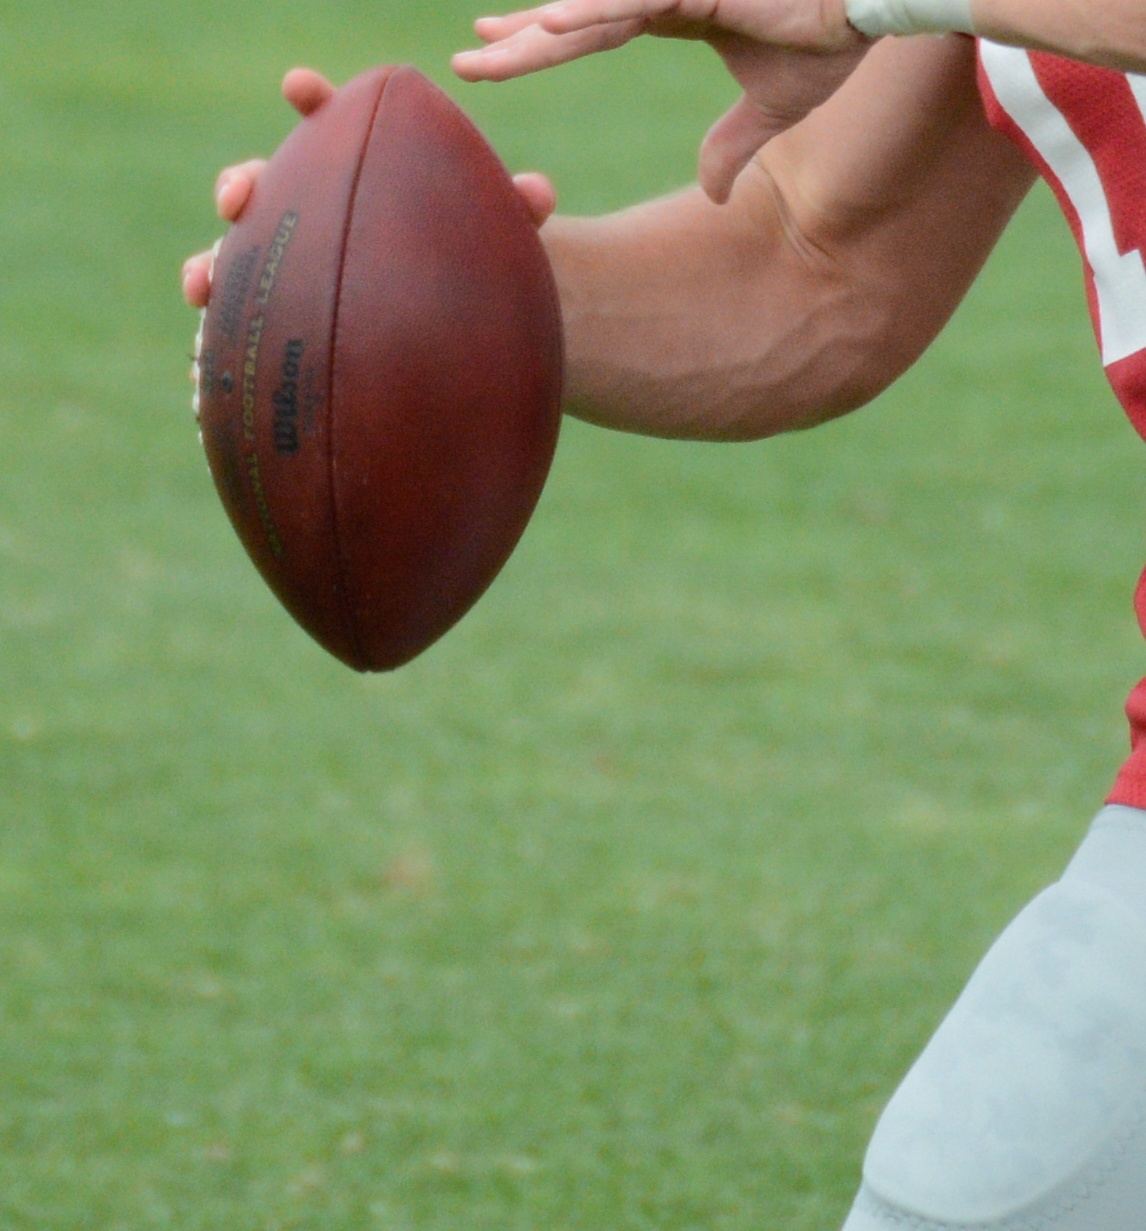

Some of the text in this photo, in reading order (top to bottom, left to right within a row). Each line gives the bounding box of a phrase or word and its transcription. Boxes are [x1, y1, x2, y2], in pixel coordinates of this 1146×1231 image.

[243, 316, 264, 441] FOOTBALL
[257, 209, 298, 304] LEAGUE
[272, 339, 304, 455] Wilson
